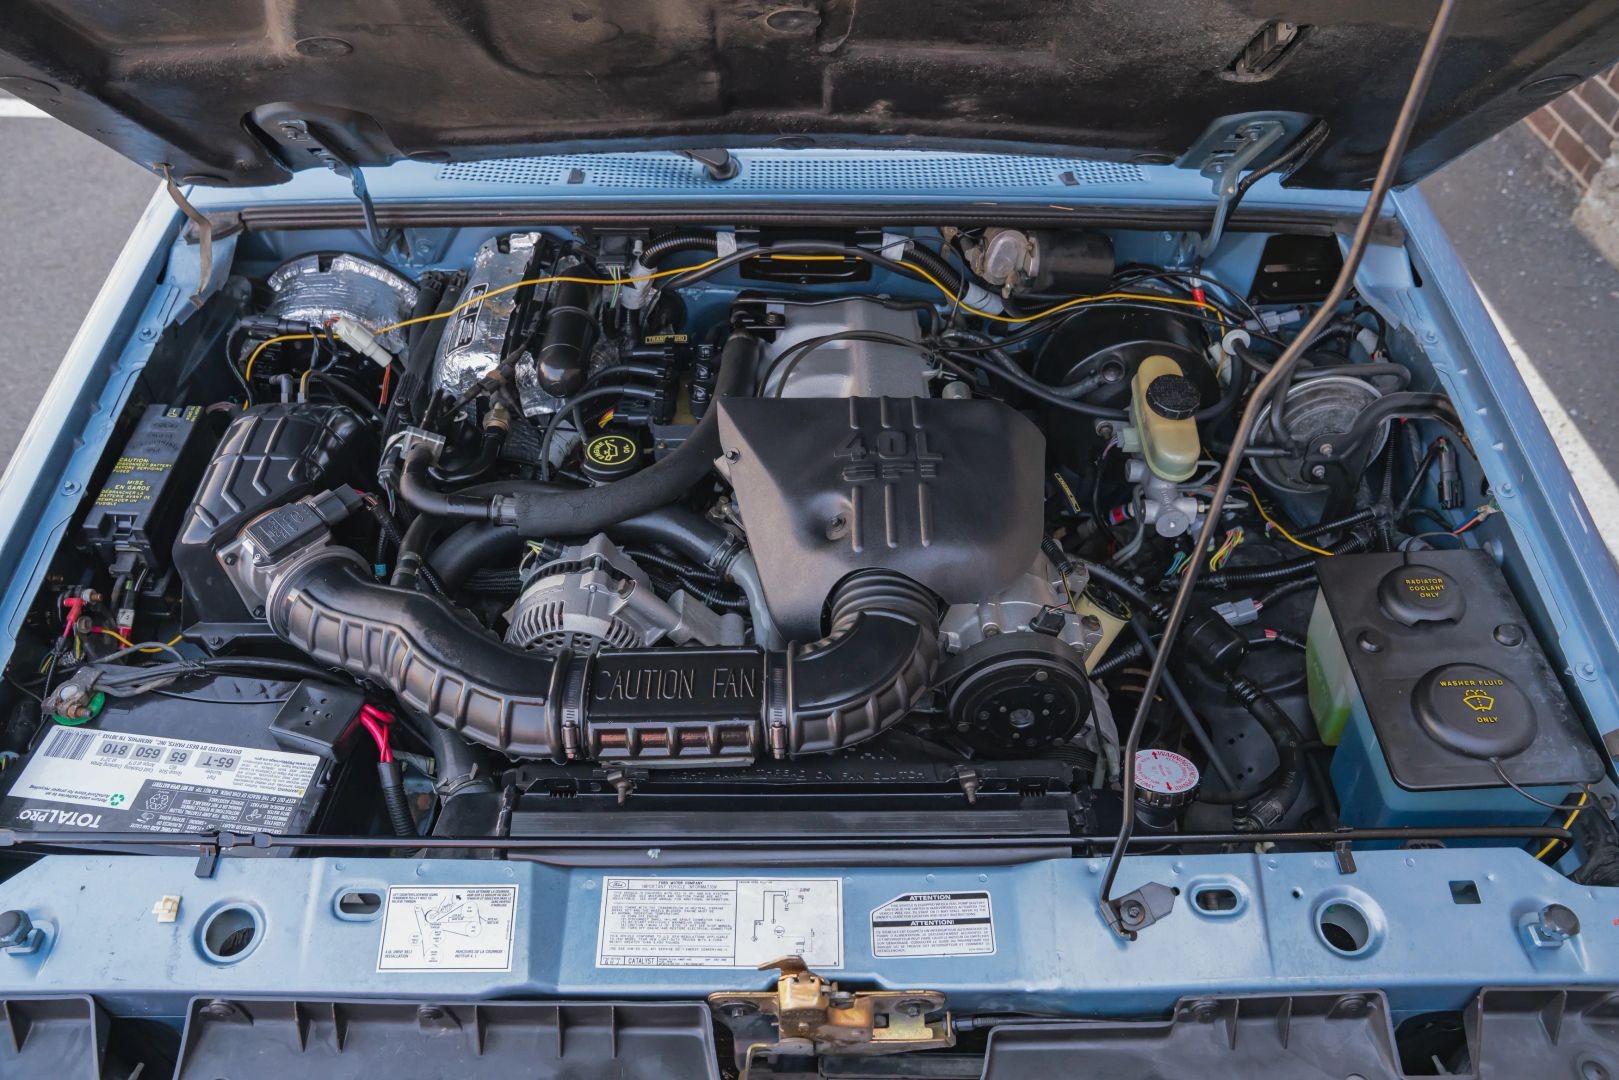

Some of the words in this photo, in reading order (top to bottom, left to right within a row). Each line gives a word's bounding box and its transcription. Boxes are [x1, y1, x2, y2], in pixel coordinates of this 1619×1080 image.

[595, 669, 694, 700] CAUTION
[712, 667, 756, 698] FAN
[1476, 716, 1498, 724] ONLY
[103, 744, 128, 755] 810
[136, 747, 160, 758] 650
[208, 746, 242, 754] DISTRIBUTED
[170, 752, 188, 763] 65
[202, 756, 234, 768] 65-T
[628, 957, 655, 965] CATALYST
